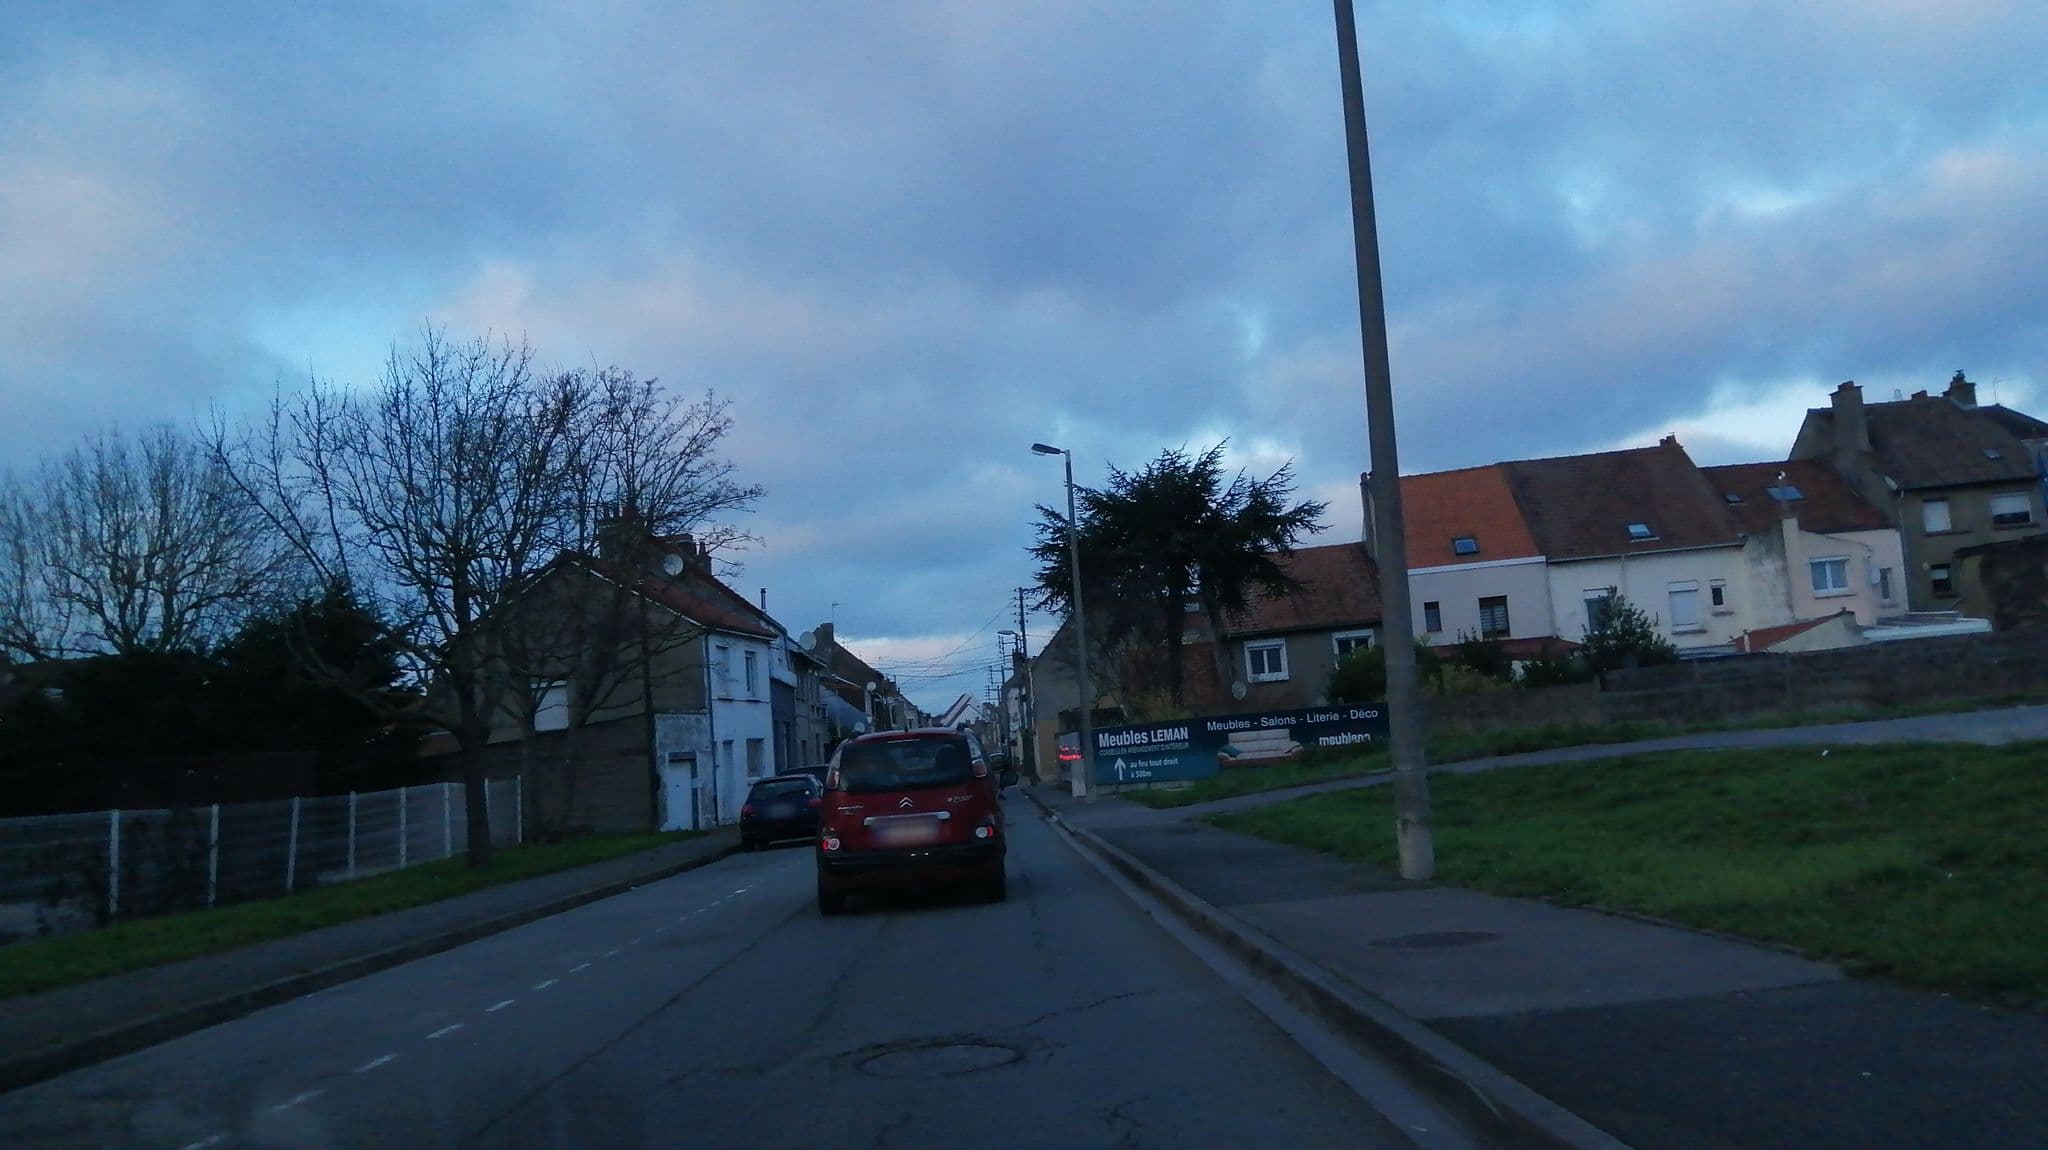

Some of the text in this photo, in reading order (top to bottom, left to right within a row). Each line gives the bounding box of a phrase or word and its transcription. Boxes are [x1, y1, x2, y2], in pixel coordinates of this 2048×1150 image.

[1207, 720, 1251, 731] Meubles
[1260, 716, 1296, 727] Salons
[1306, 712, 1340, 723] Literie
[1350, 709, 1378, 720] Déco
[1098, 726, 1189, 747] Meubles LEMAN
[1149, 759, 1162, 767] tout
[1163, 757, 1179, 766] droit
